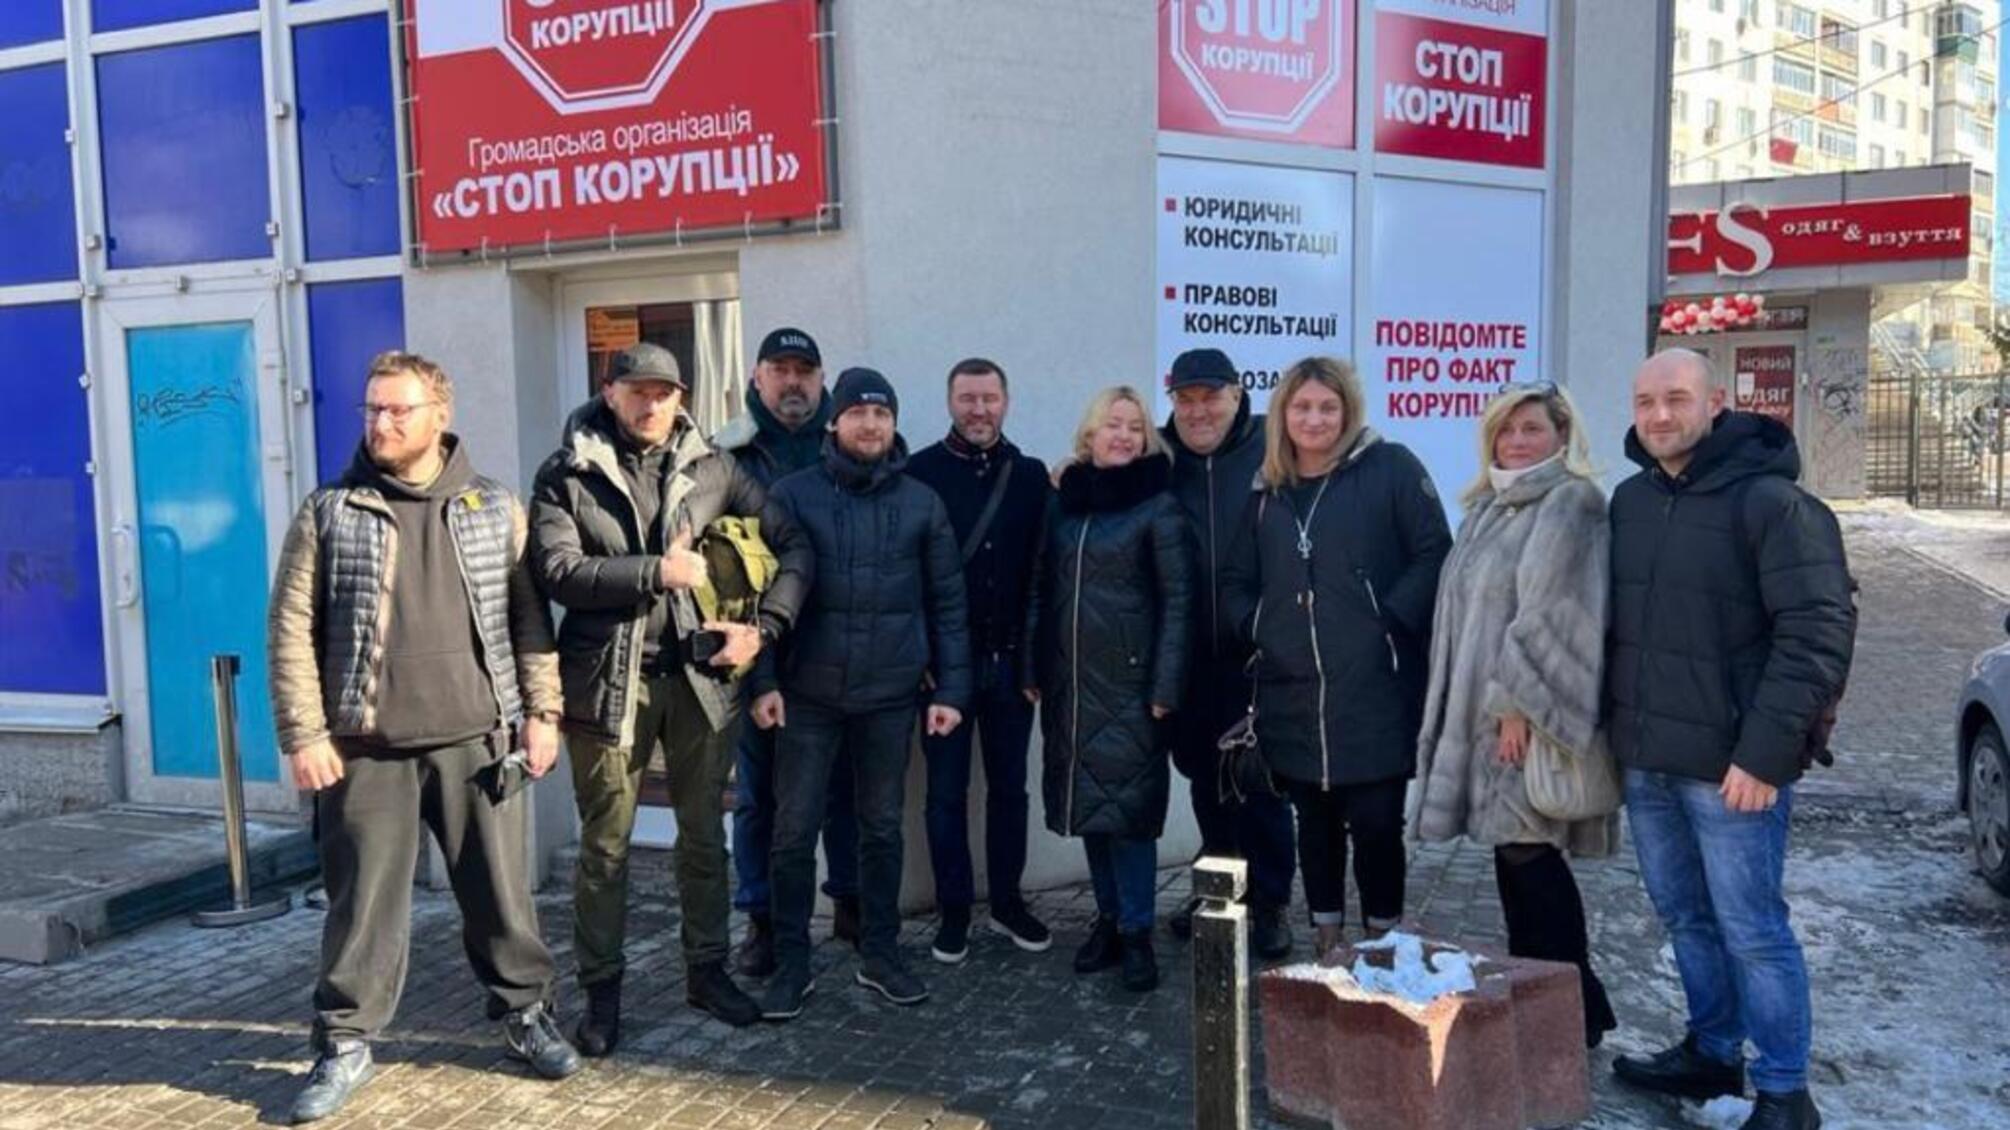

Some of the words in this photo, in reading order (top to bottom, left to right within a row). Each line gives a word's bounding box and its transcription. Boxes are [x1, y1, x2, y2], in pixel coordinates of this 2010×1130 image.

[1201, 43, 1315, 82] КОРУПЦІЇ
[1415, 39, 1503, 87] СТОП
[1384, 82, 1531, 141] КОРУПЦІЇ
[468, 127, 607, 172] Громадська
[613, 104, 751, 154] організація
[432, 168, 562, 219] «СТОП
[1184, 197, 1301, 225] ЮРИДИЧНІ
[1781, 217, 1844, 236] одяг
[1868, 226, 1962, 248] взуття
[1184, 284, 1277, 308] ПРАВОВІ
[1184, 312, 1338, 340] КОНСУЛЬТАЦІЇ
[1376, 321, 1527, 352] ПОВІДОМТЕ
[1386, 356, 1439, 382] ПРО
[1449, 358, 1516, 384] ФАКТ
